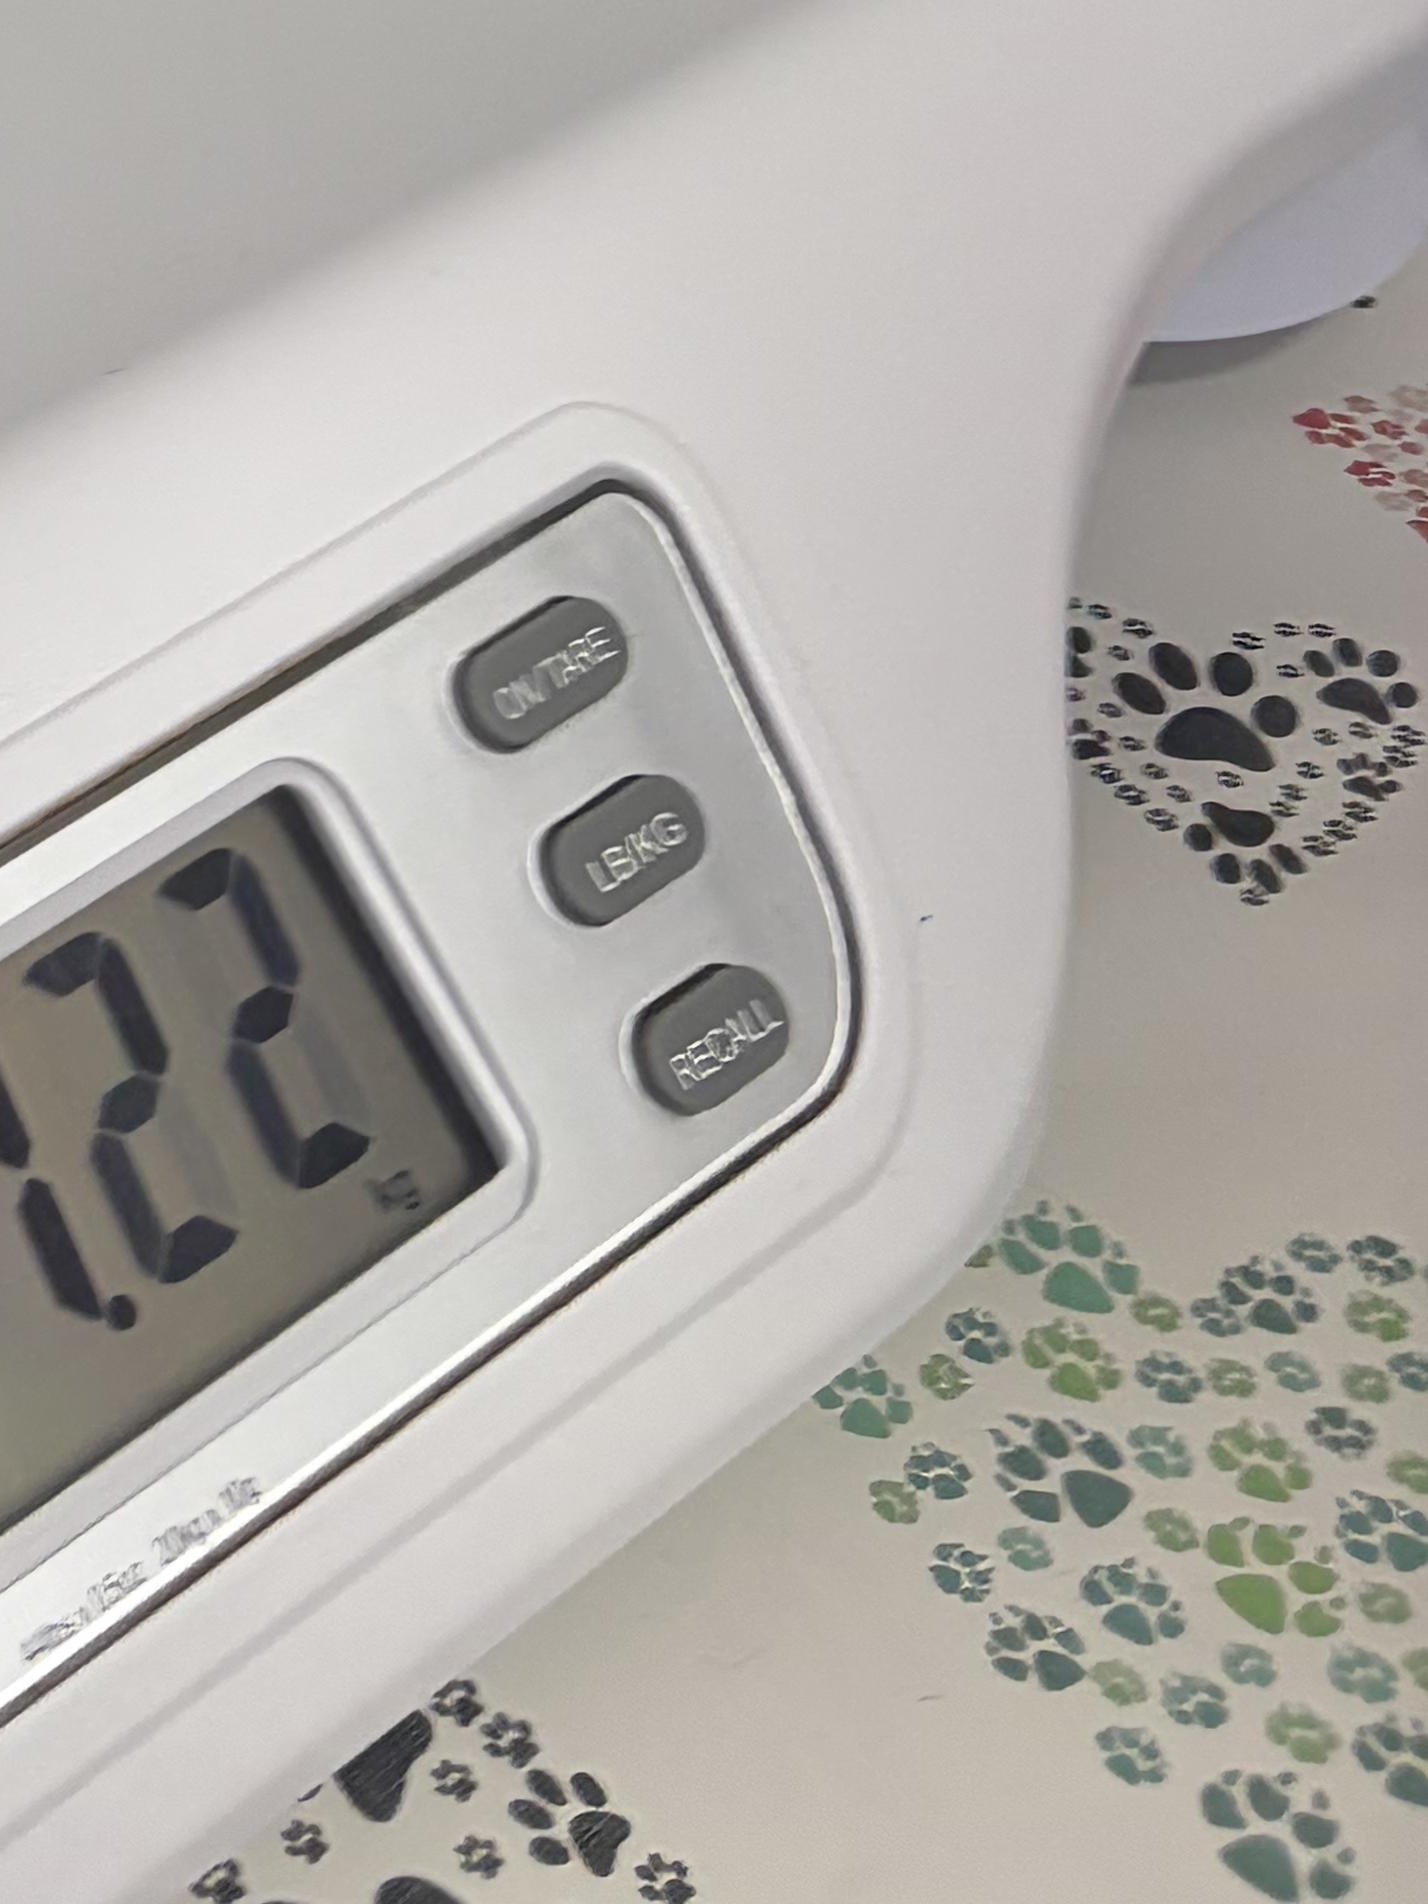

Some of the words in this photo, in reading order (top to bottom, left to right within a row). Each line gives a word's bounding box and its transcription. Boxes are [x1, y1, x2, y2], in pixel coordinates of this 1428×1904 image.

[494, 626, 621, 720] ON/TARE
[585, 812, 688, 894] LB/KG
[668, 999, 785, 1090] RECALL
